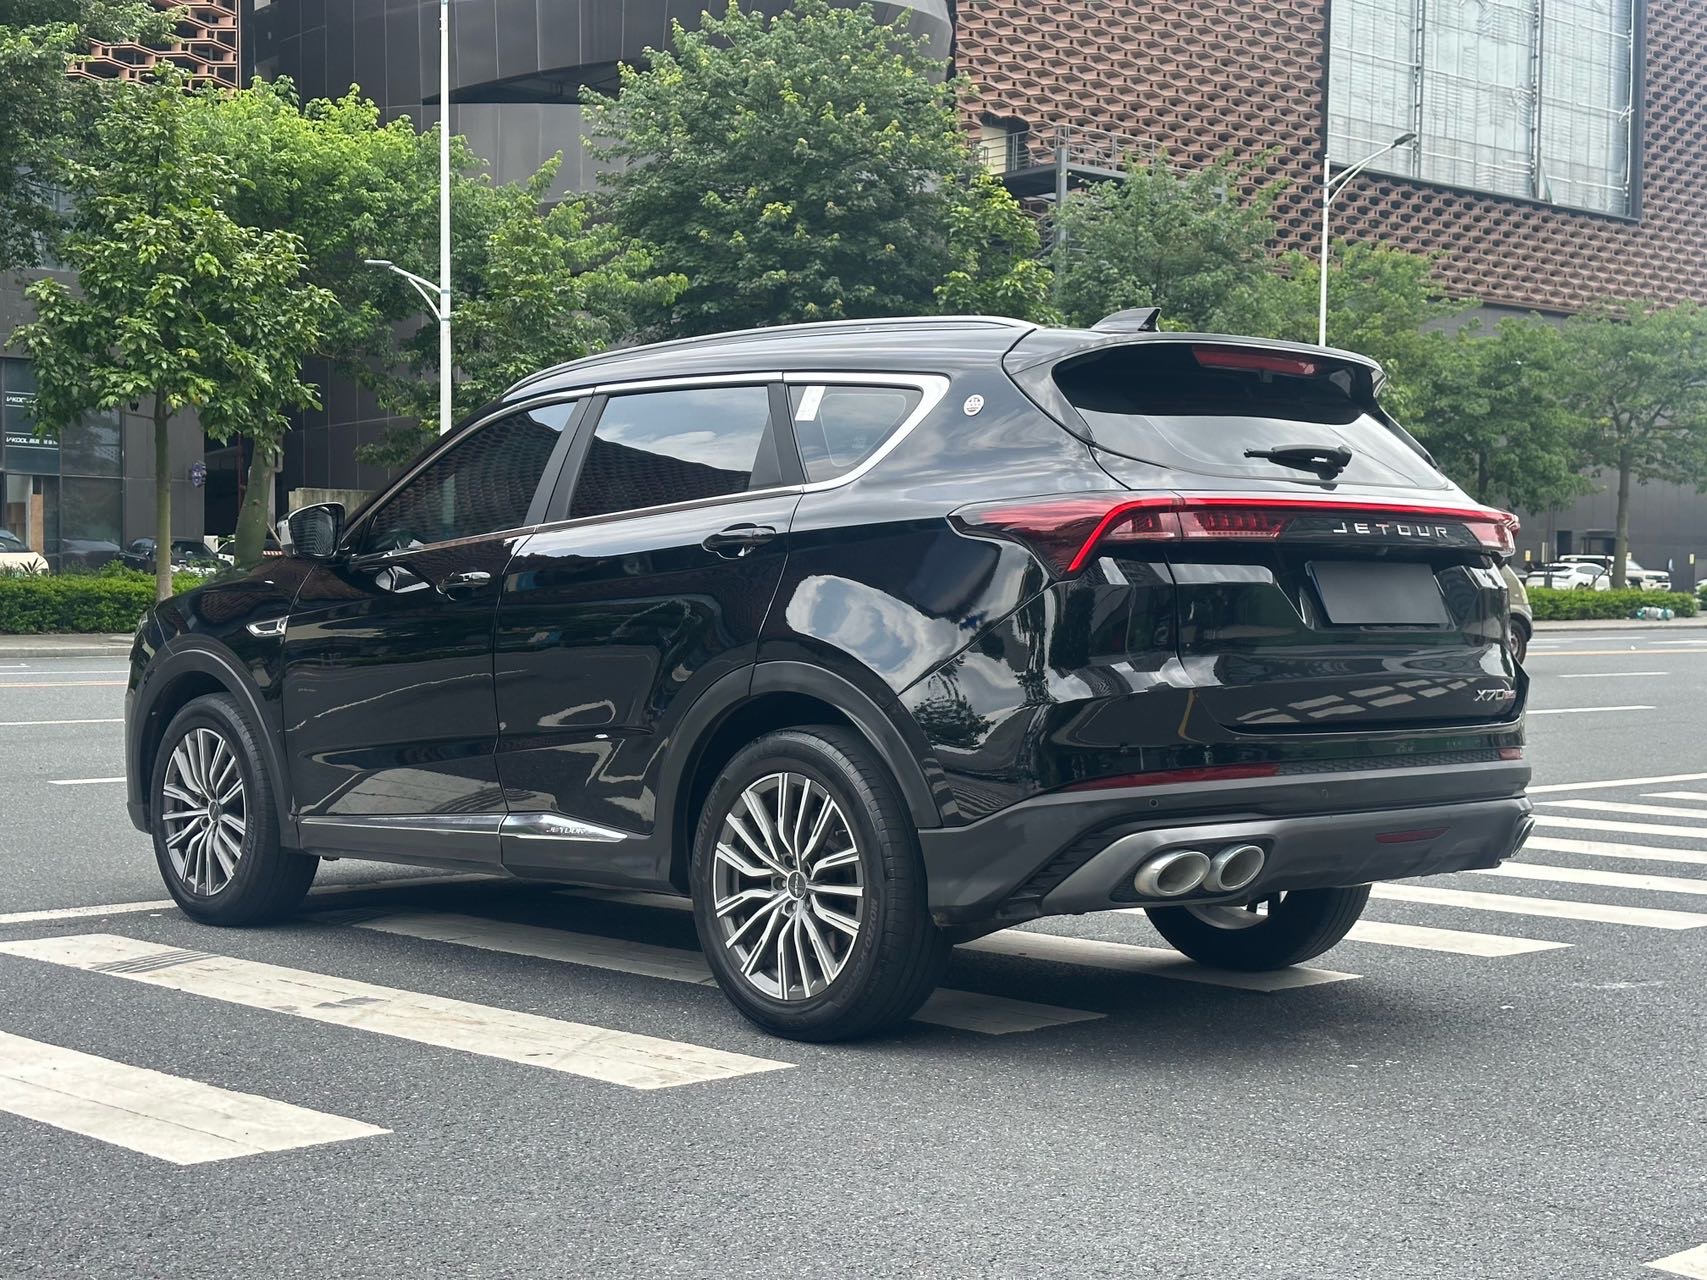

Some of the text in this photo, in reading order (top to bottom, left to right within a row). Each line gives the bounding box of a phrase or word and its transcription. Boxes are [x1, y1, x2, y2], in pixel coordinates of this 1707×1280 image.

[1333, 522, 1449, 538] JETOUR
[1474, 689, 1505, 702] X70
[695, 784, 722, 867] DURATU
